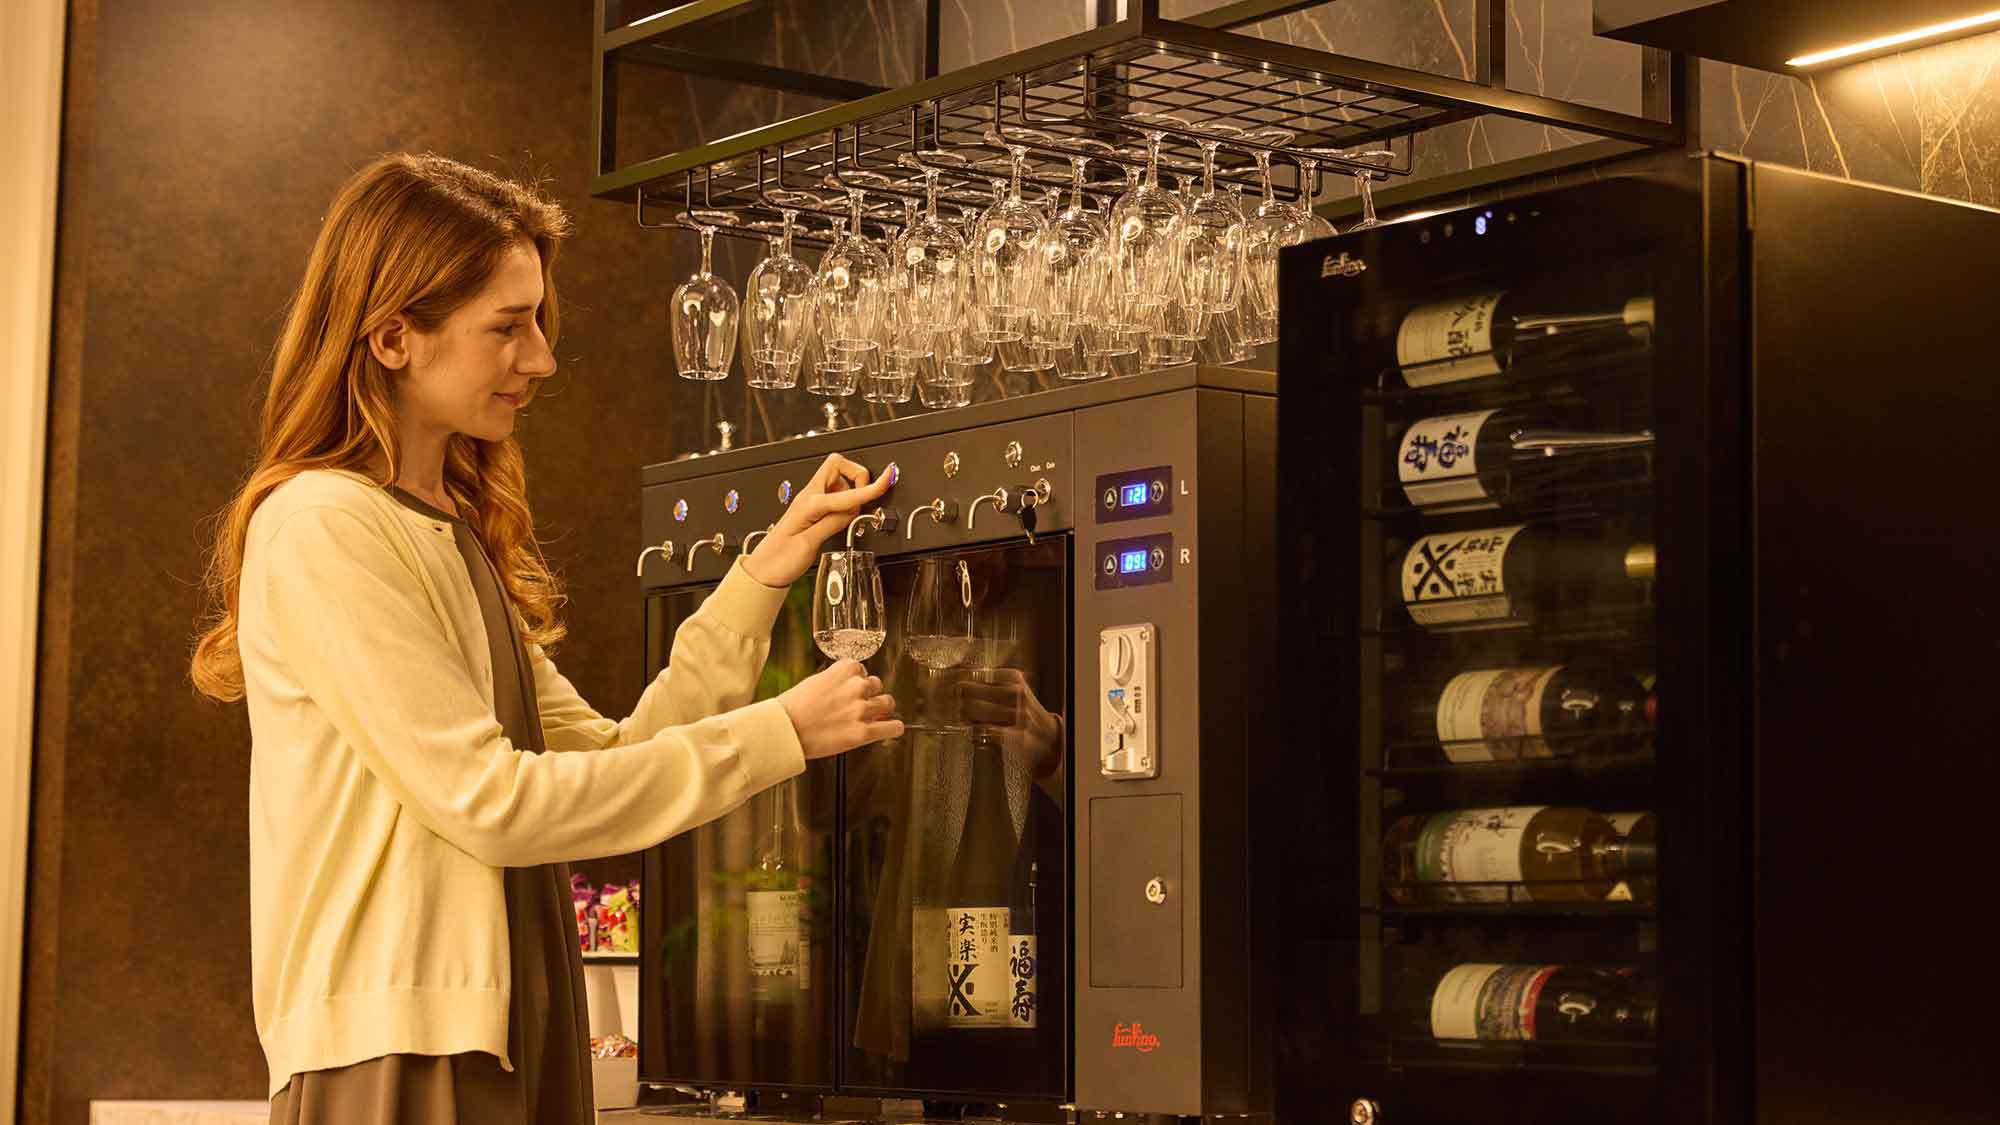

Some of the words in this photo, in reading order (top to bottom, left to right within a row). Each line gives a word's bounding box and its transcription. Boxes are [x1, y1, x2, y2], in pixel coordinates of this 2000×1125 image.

[1180, 480, 1189, 495] L
[1180, 548, 1190, 564] R
[959, 912, 977, 962] 実楽
